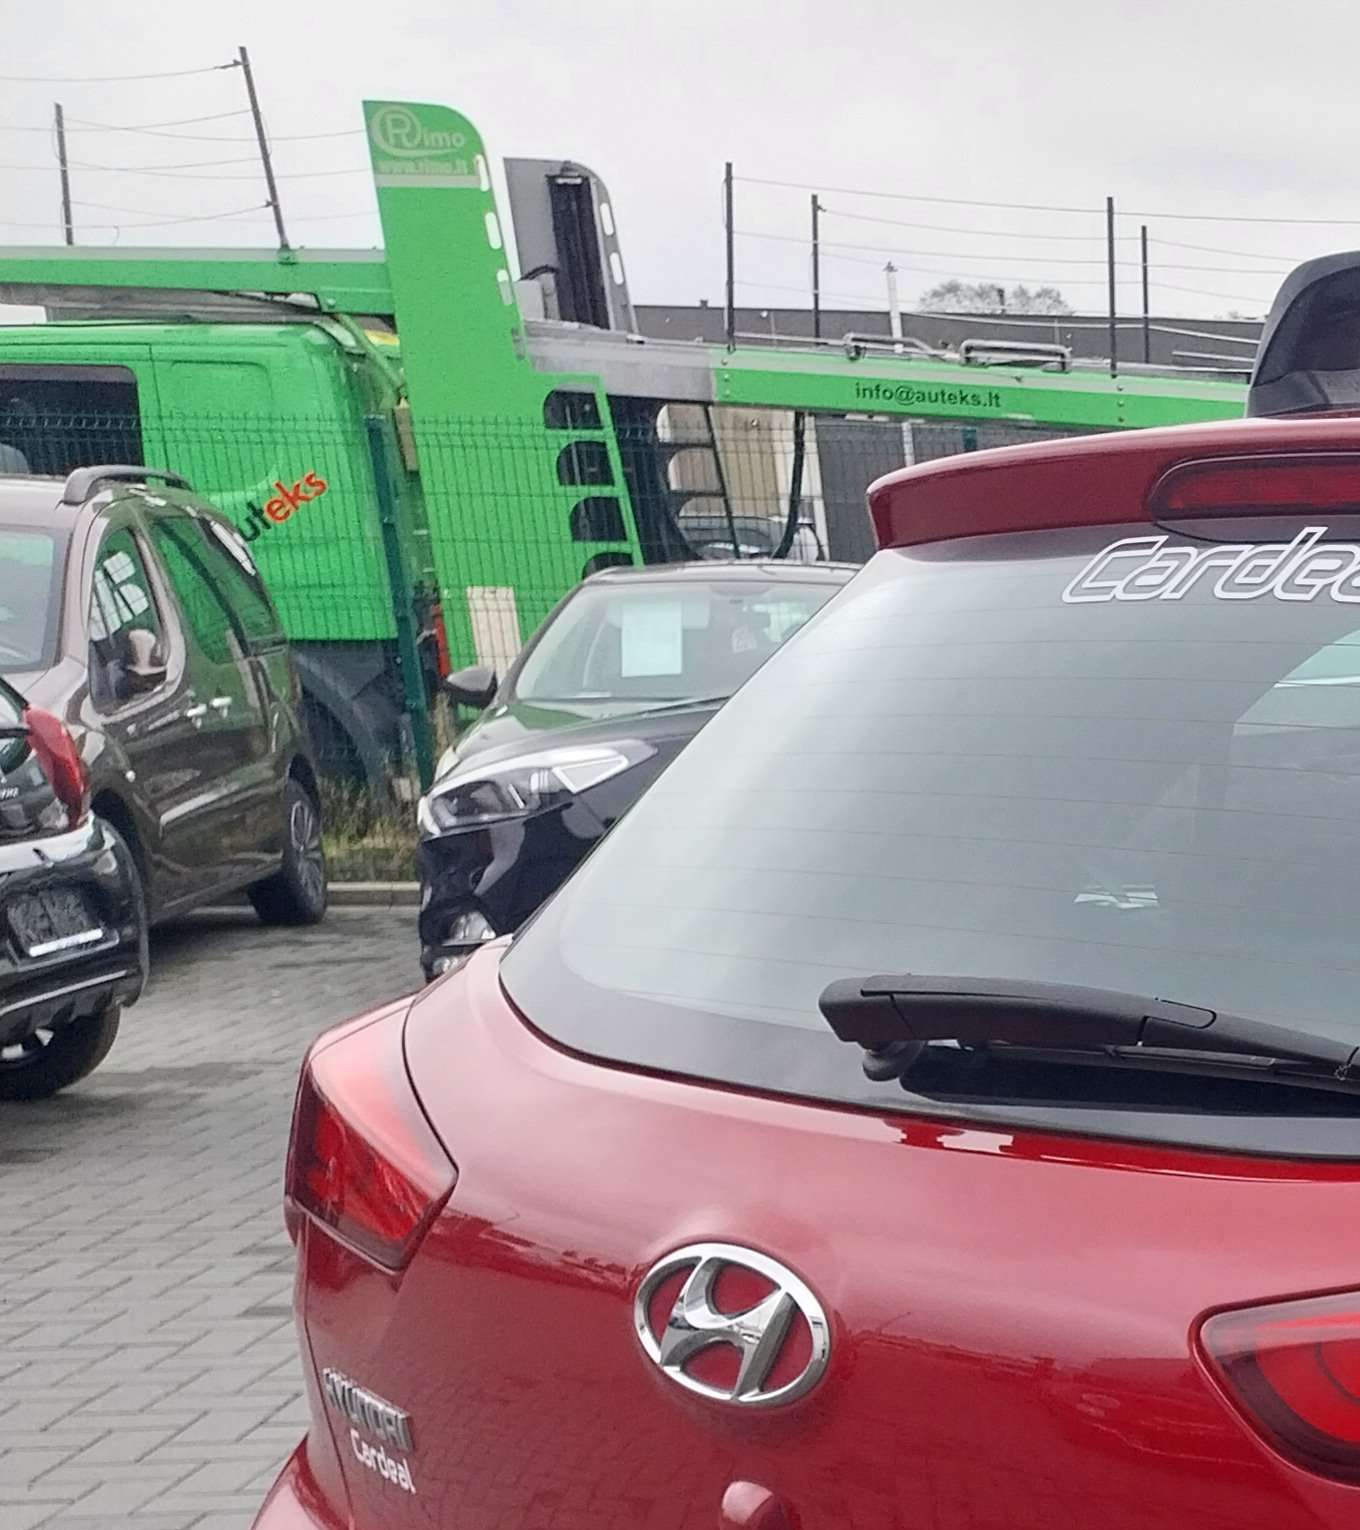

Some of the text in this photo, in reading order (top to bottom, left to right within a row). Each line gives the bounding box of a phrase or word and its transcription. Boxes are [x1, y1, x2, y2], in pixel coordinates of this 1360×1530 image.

[855, 381, 1001, 408] info@auteks.lt
[239, 471, 327, 541] uteks
[349, 1428, 416, 1494] Cardeal
